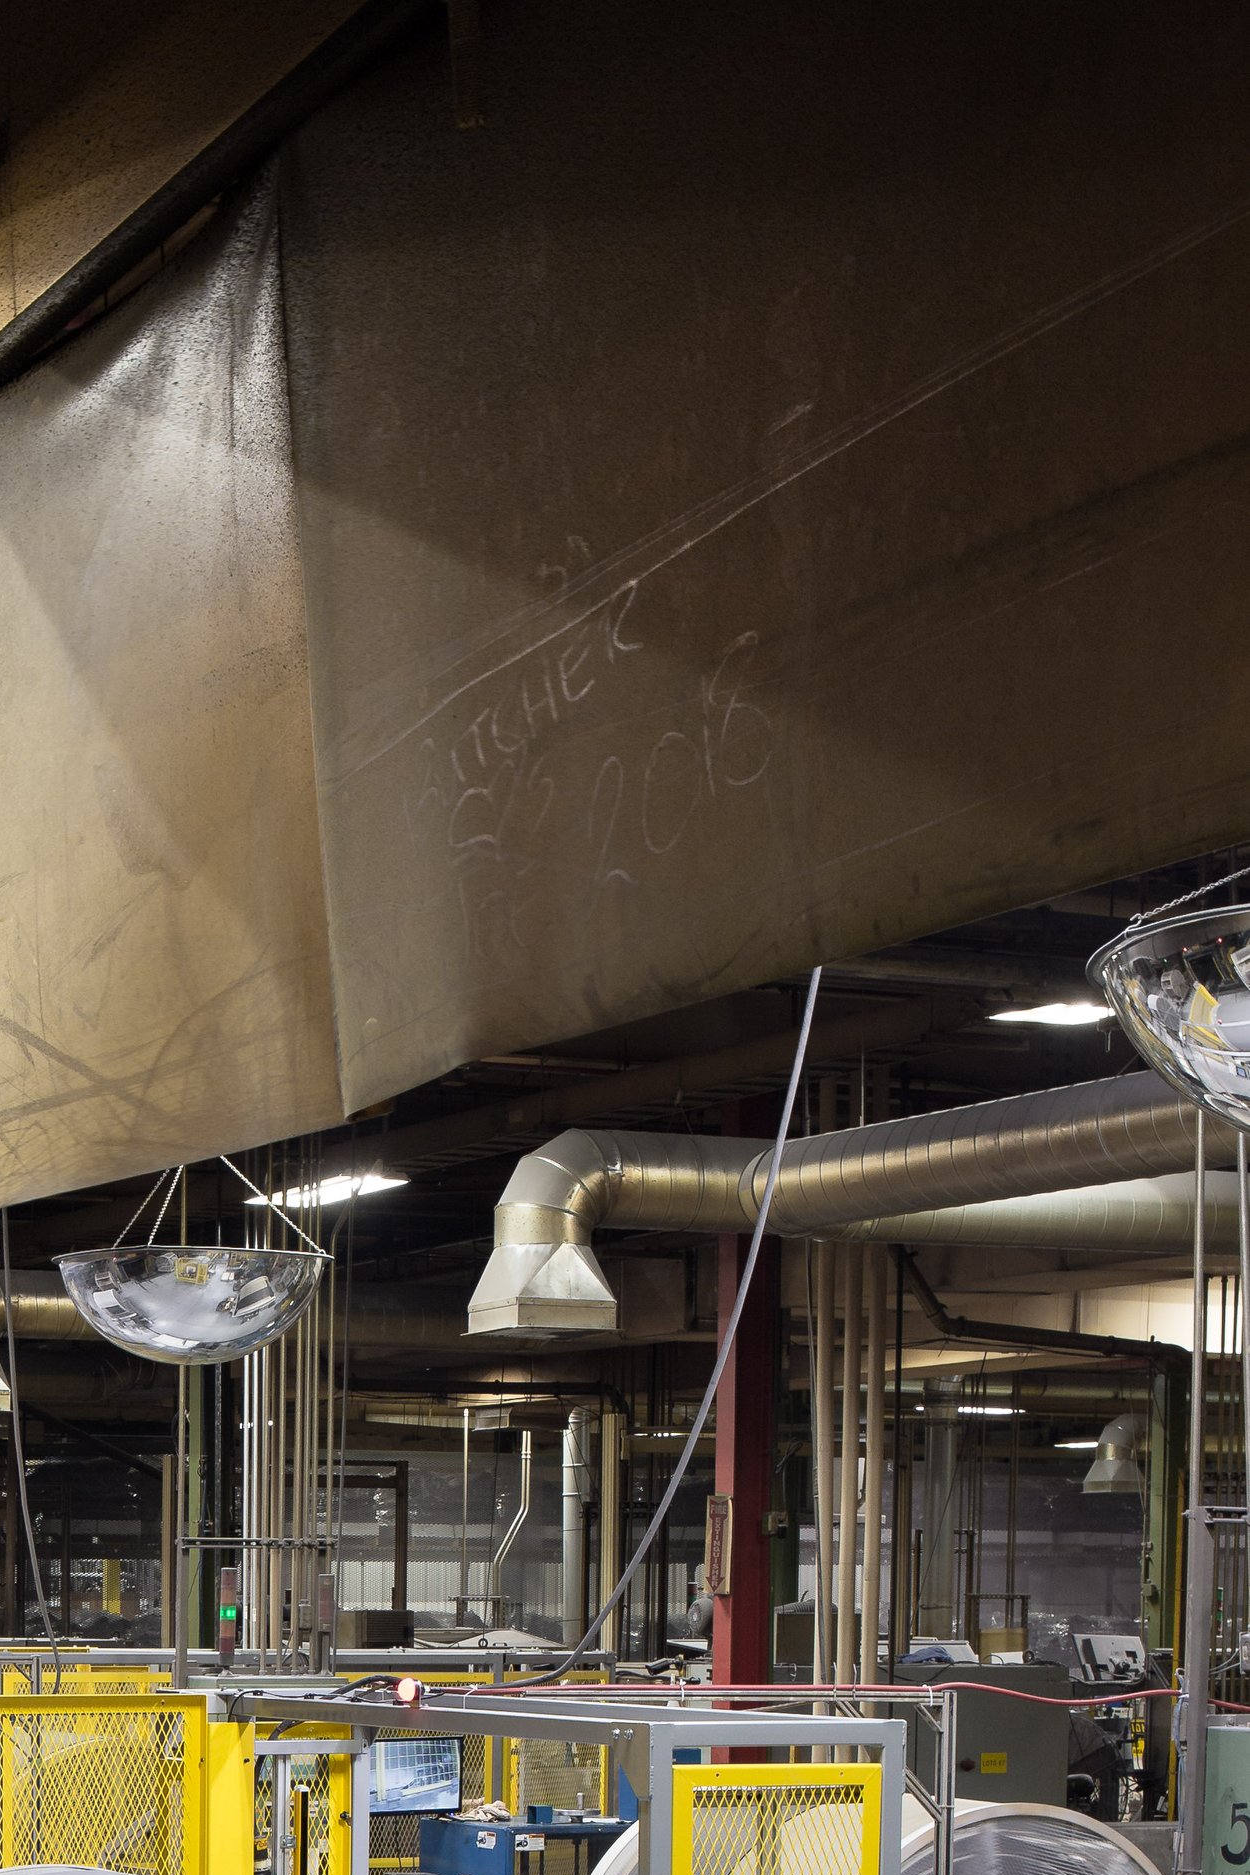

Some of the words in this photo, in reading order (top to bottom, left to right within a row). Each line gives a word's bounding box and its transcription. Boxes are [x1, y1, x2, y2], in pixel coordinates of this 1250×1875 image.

[711, 1504, 727, 1514] FIRE
[711, 1517, 721, 1587] EXTINGUISHER
[1220, 1803, 1250, 1865] 5
